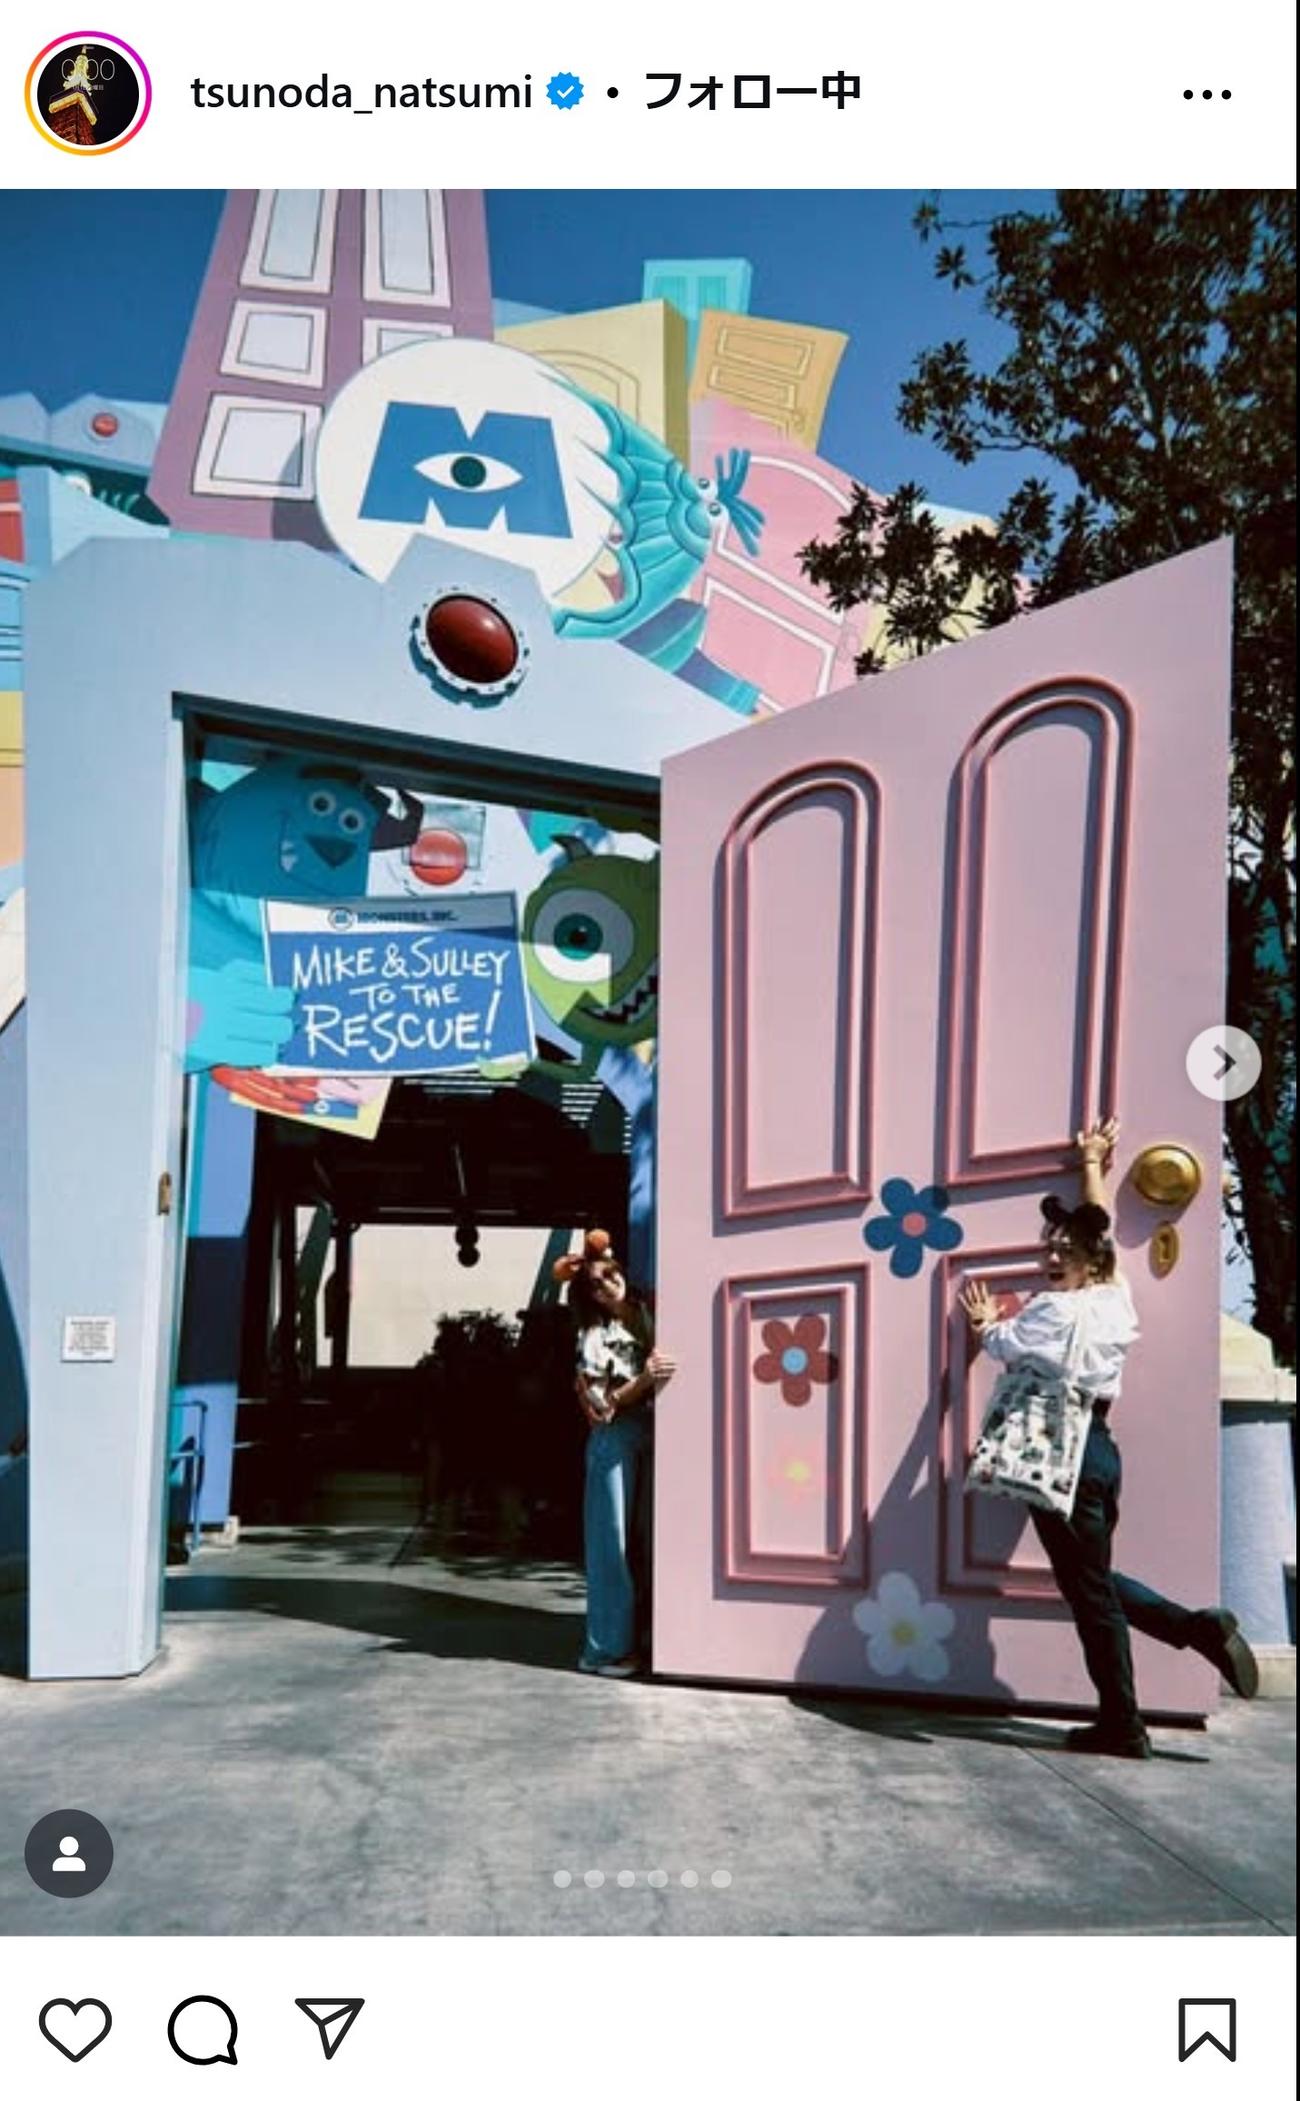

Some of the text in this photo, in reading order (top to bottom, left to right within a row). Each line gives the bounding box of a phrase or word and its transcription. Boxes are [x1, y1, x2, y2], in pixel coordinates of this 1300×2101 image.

[293, 936, 511, 990] MIKE & SULLEY
[349, 982, 461, 1012] TO THE
[301, 988, 503, 1063] RESCUE!
